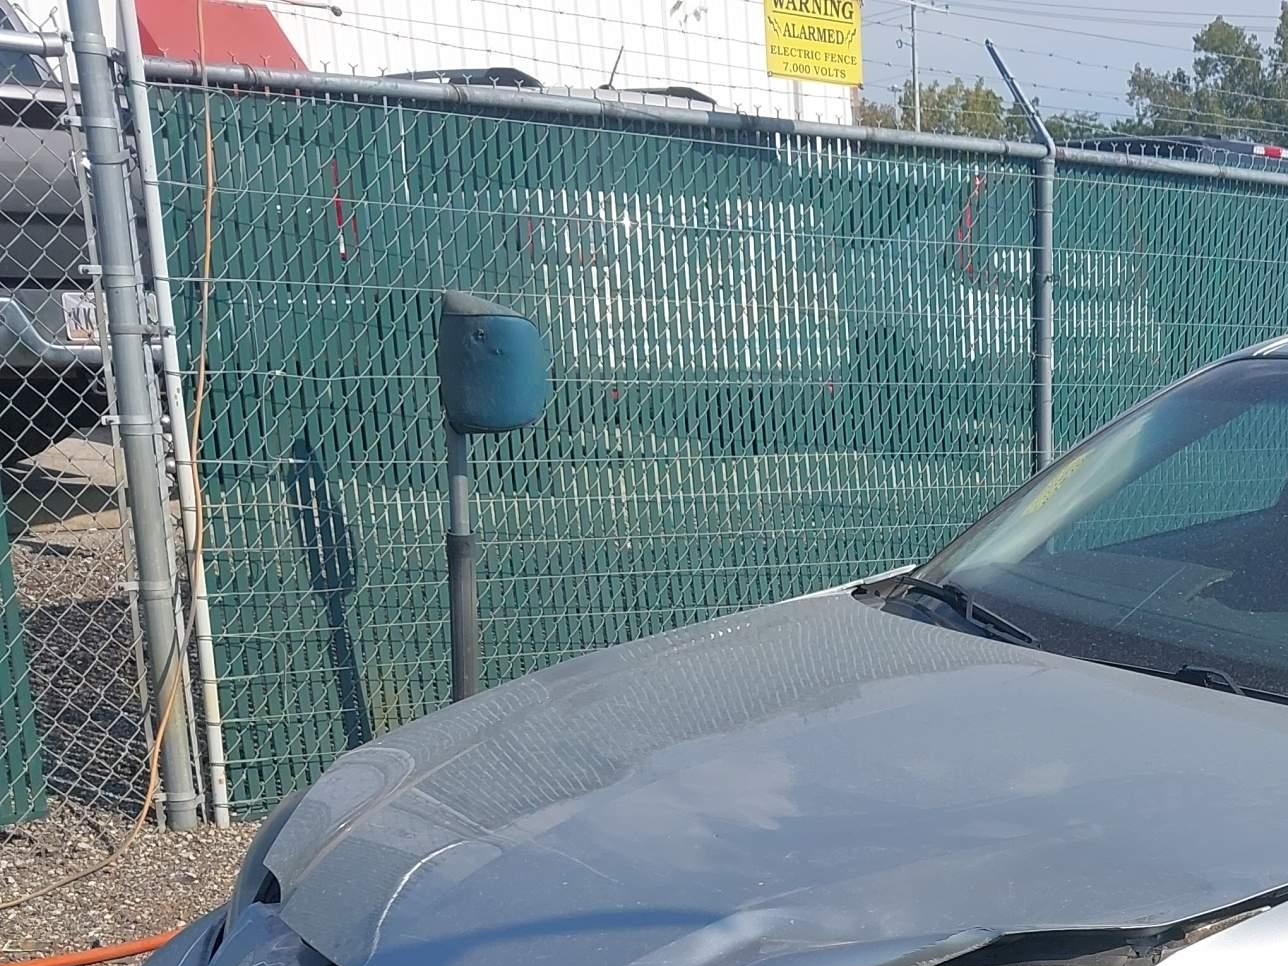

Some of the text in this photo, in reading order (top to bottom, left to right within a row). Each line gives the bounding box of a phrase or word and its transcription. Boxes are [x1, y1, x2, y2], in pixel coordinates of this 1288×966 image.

[772, 0, 854, 20] WARNING
[783, 22, 844, 45] ALARMED
[770, 45, 857, 65] ELECTRIC FENCE
[813, 66, 847, 79] VOLTS
